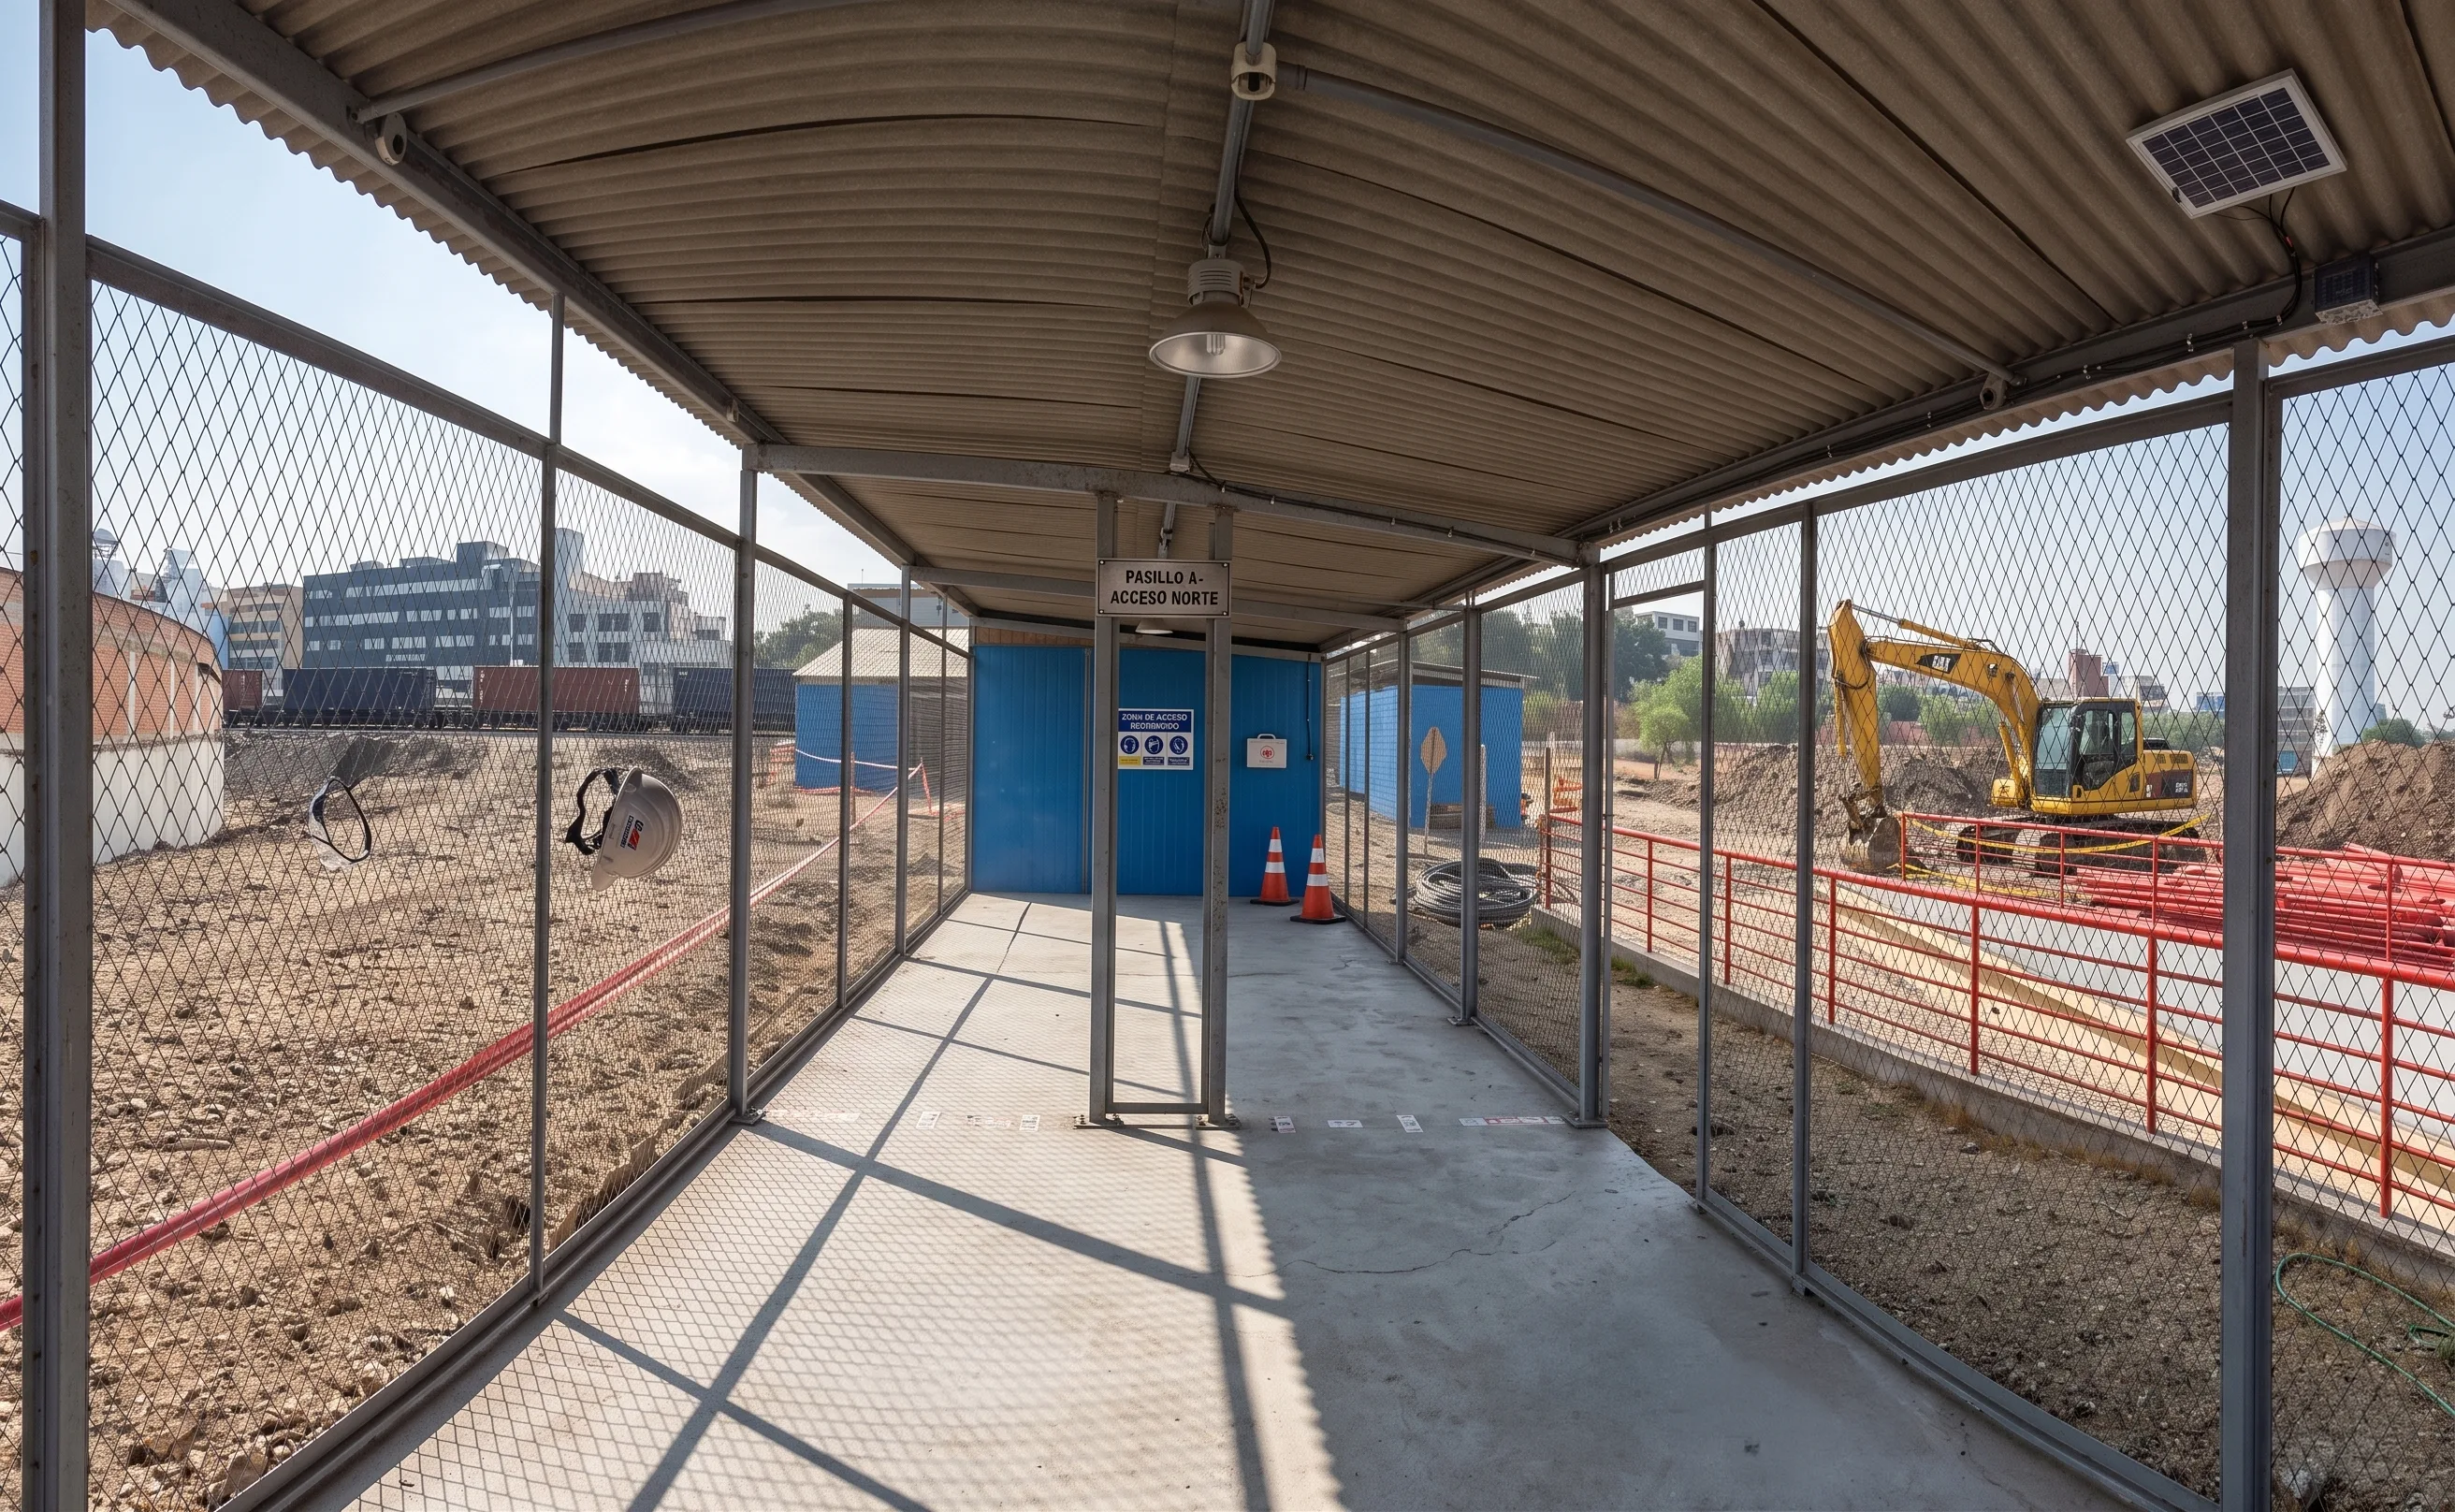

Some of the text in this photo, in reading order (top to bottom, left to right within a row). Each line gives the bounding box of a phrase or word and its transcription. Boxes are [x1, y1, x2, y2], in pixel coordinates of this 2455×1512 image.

[1126, 570, 1184, 584] PASILLO
[1110, 590, 1218, 605] ACCESO NORTE
[1156, 713, 1187, 721] ACCESO
